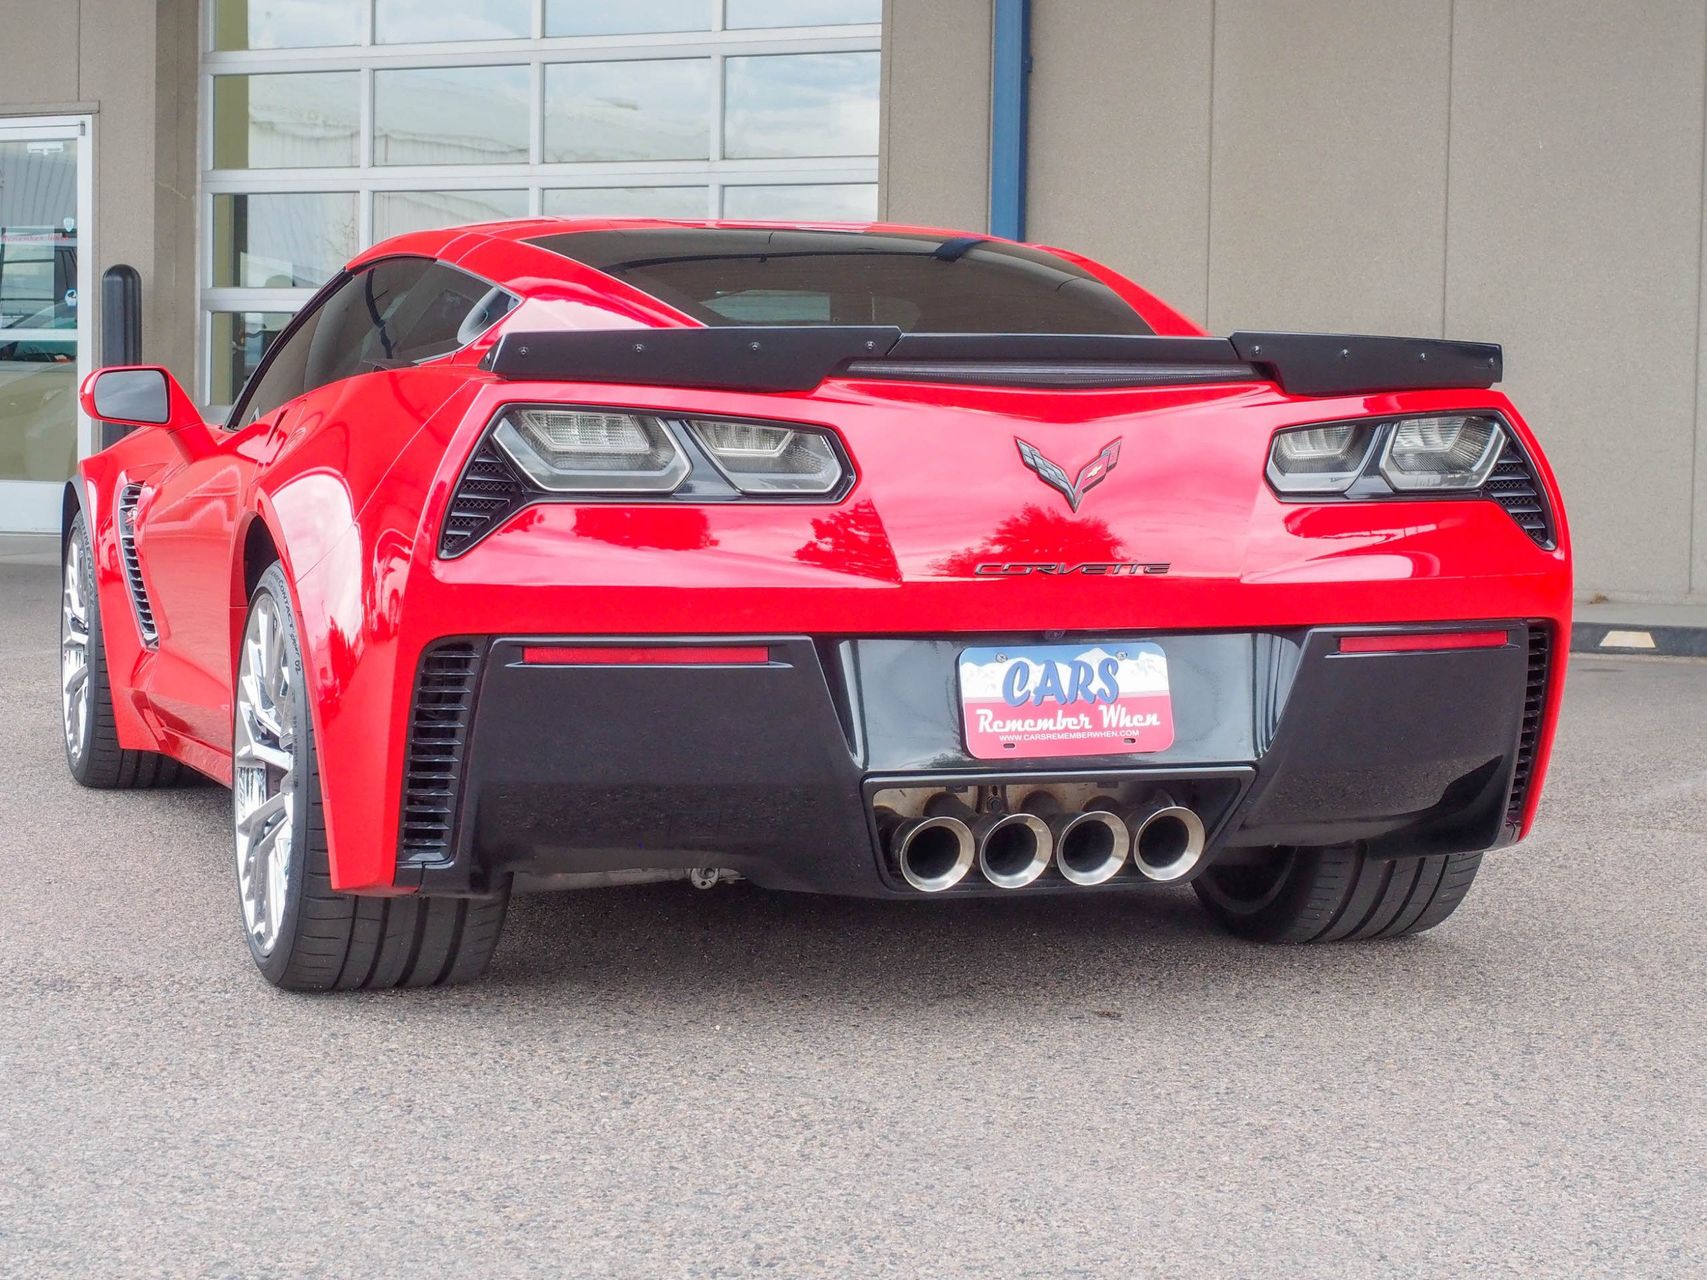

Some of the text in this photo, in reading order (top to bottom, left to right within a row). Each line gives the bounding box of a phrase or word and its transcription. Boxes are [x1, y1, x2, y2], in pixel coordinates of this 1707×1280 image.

[974, 562, 1171, 575] CORVETTE
[1002, 657, 1119, 707] CARS
[976, 704, 1161, 733] Remember When
[999, 730, 1140, 741] WWW.CARSREMEMBERWHEN.COM
